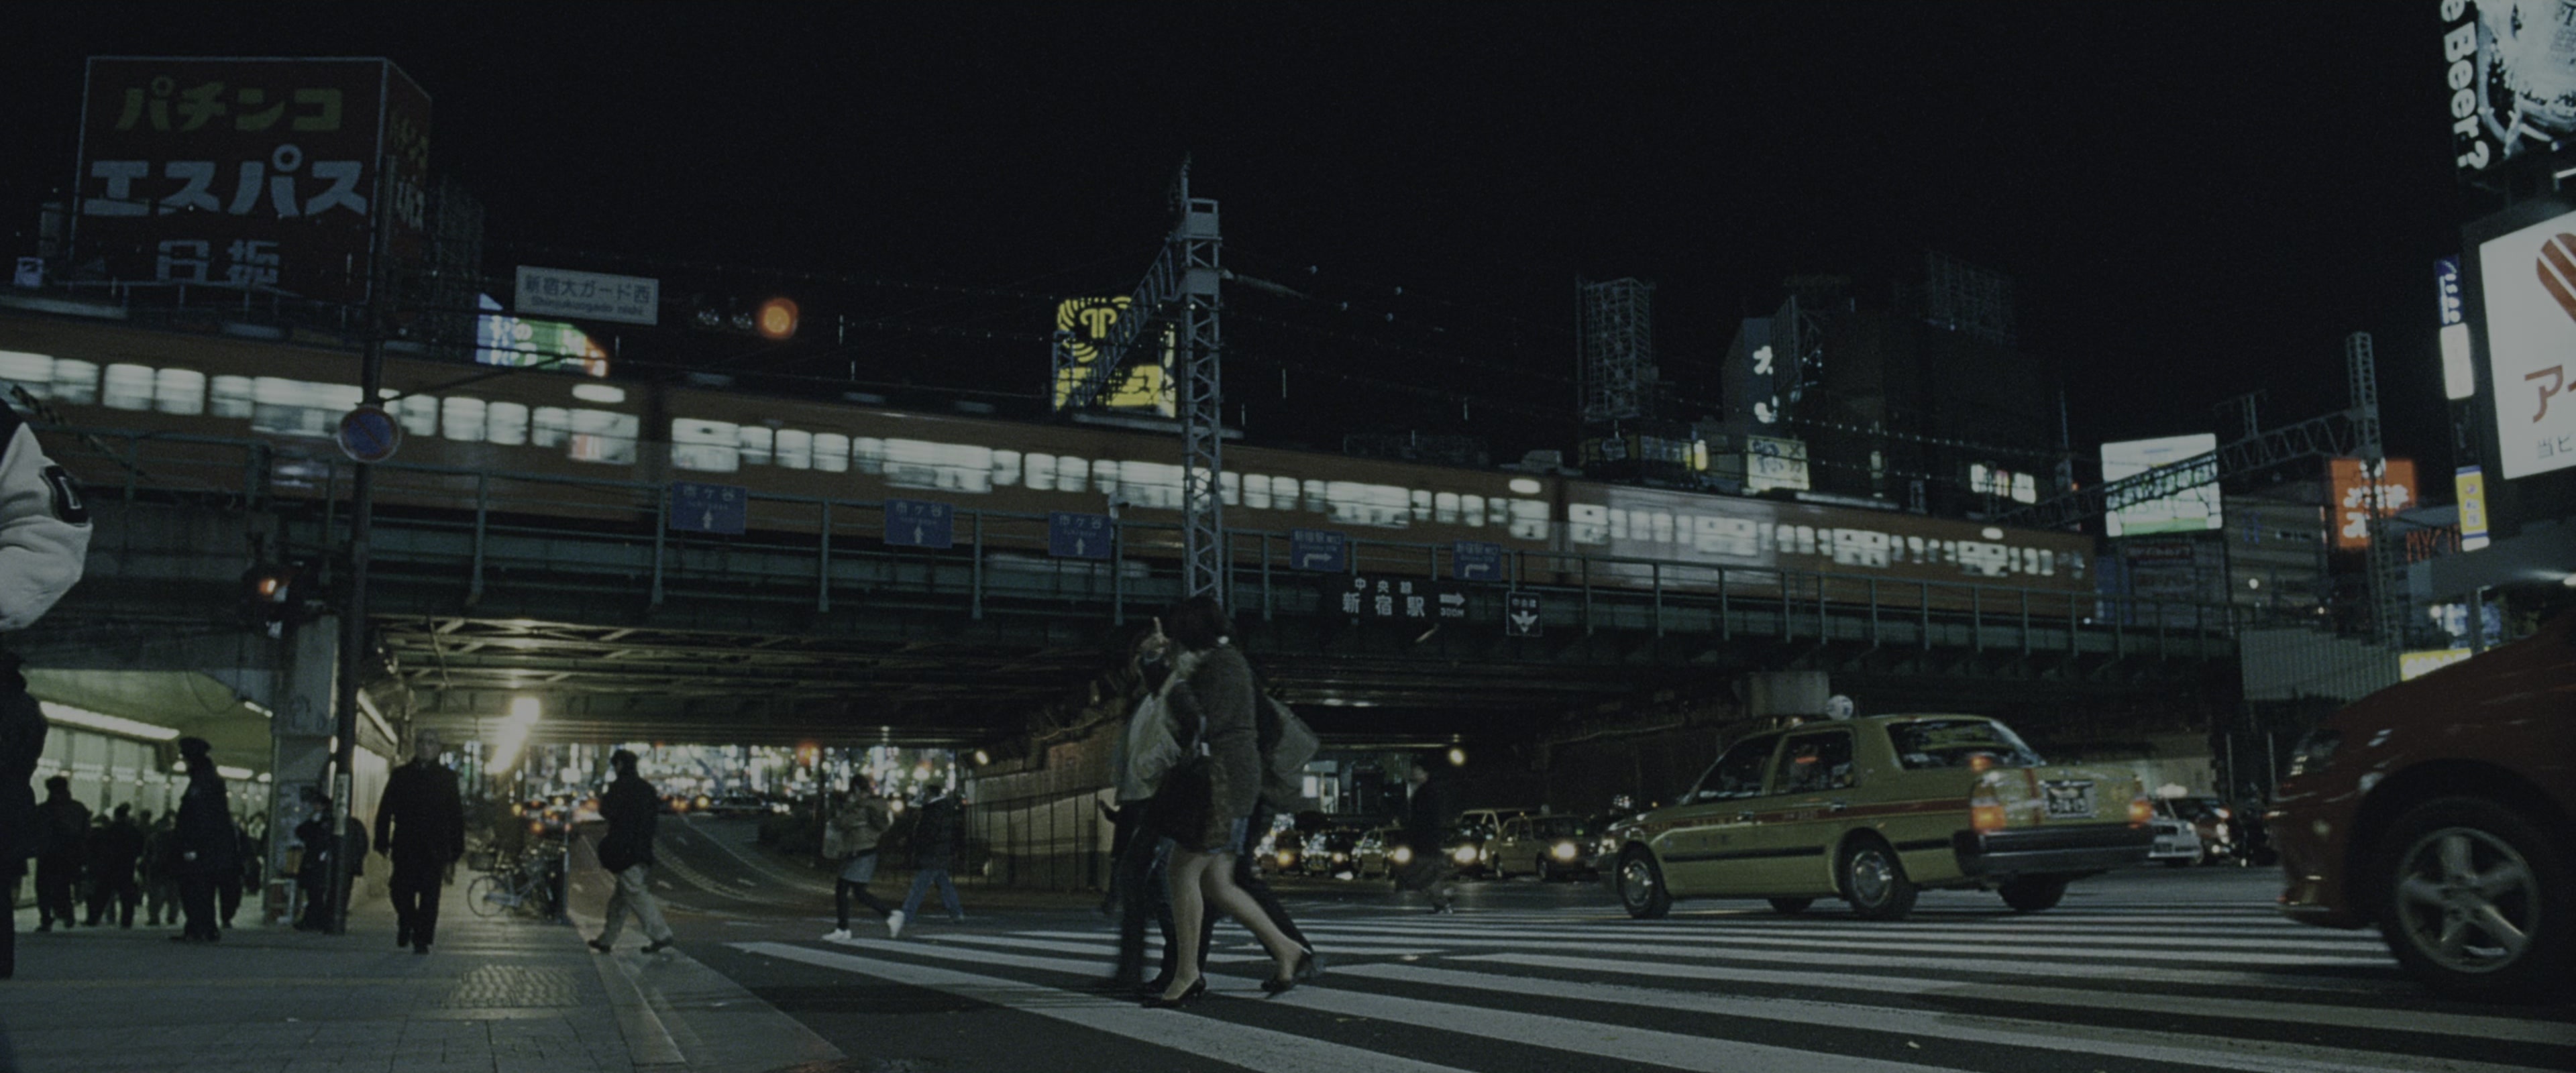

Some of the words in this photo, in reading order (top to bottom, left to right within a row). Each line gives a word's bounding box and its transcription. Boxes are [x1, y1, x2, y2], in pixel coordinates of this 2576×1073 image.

[114, 73, 343, 132] パチンコ
[2443, 21, 2490, 169] Beer?
[83, 143, 368, 217] エスパス
[525, 275, 651, 304] 新宿大ガード西
[2524, 364, 2576, 422] ア
[1342, 591, 1426, 618] 新宿駅
